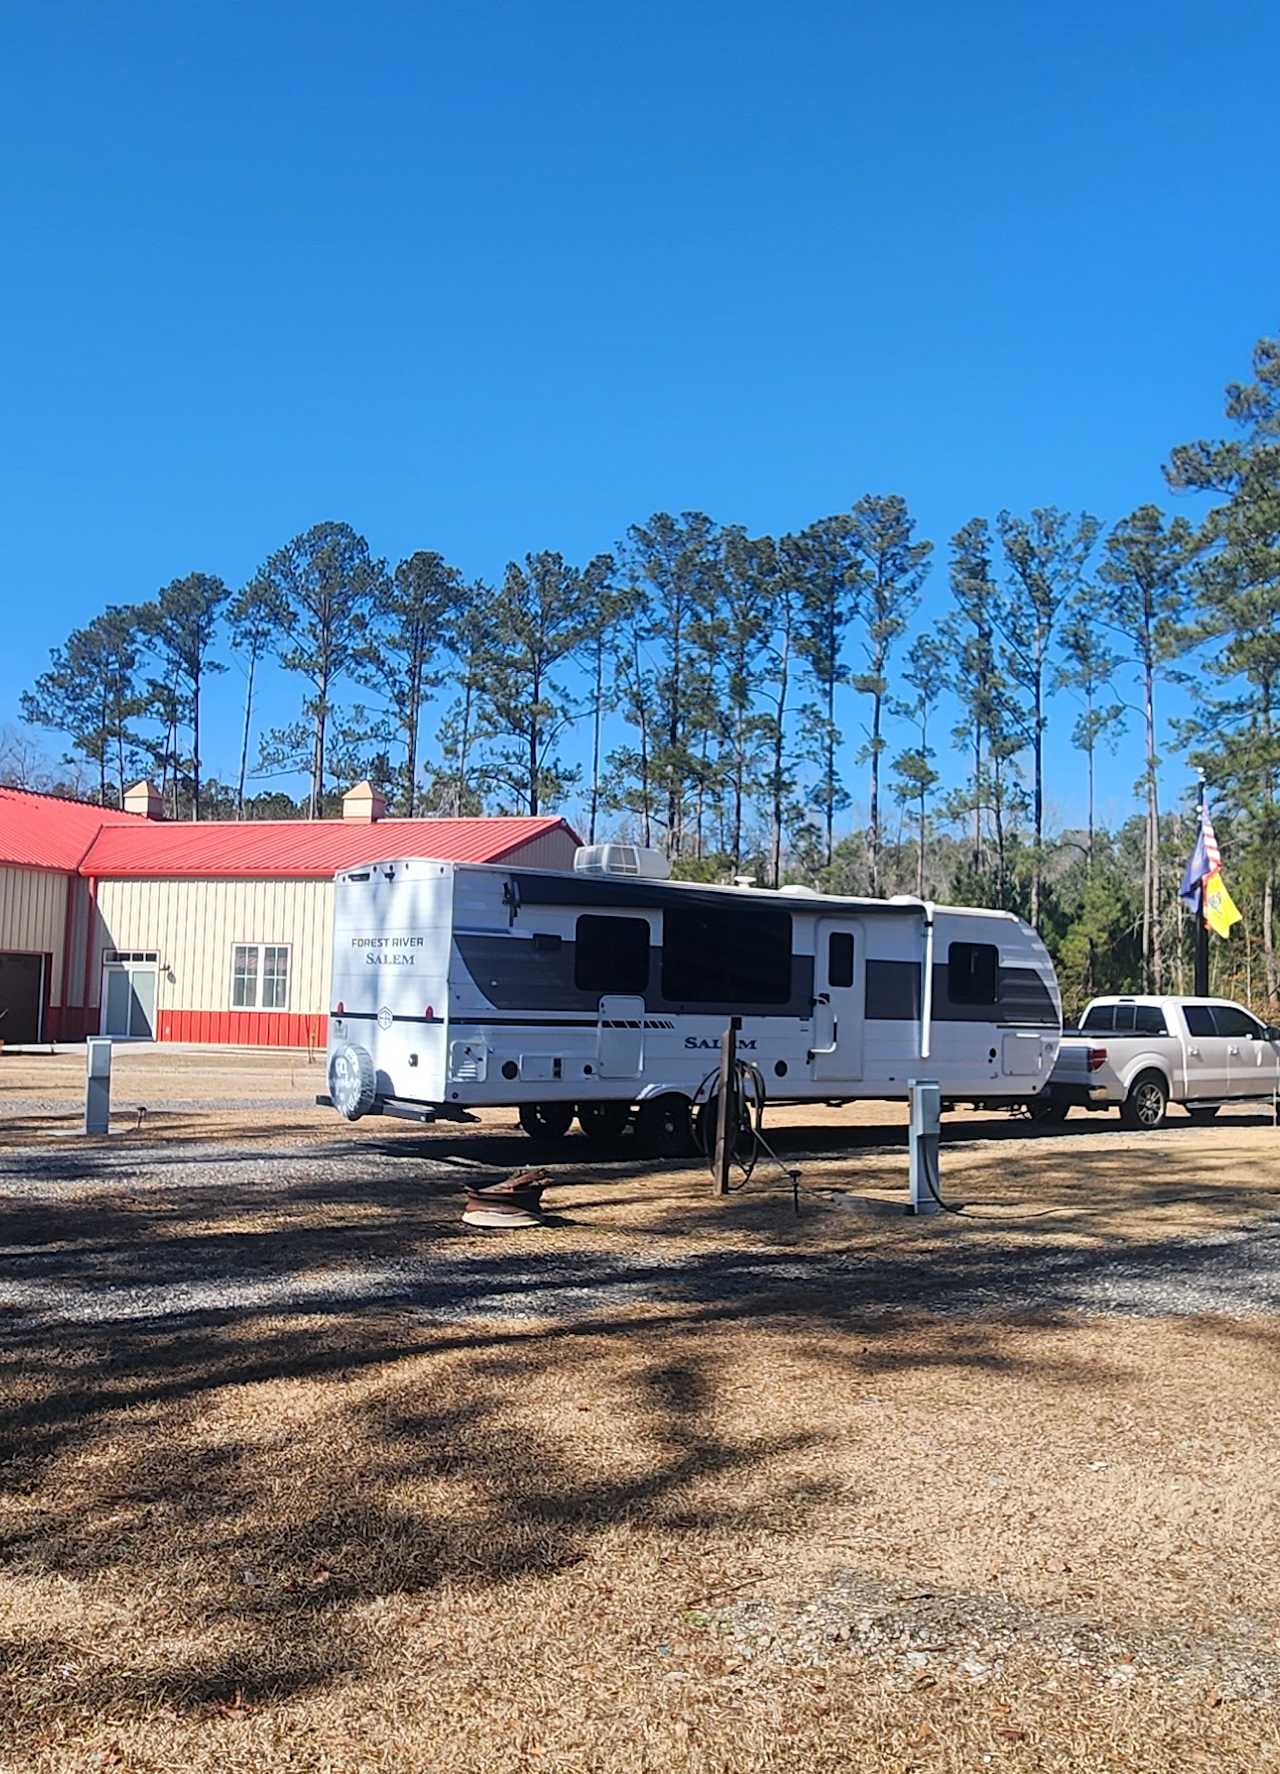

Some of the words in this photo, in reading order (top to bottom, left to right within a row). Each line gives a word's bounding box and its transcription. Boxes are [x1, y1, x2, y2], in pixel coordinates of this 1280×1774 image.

[351, 938, 389, 948] FOREST
[392, 937, 424, 947] RIVER
[365, 952, 415, 965] SALEM
[684, 1037, 757, 1050] SALM
